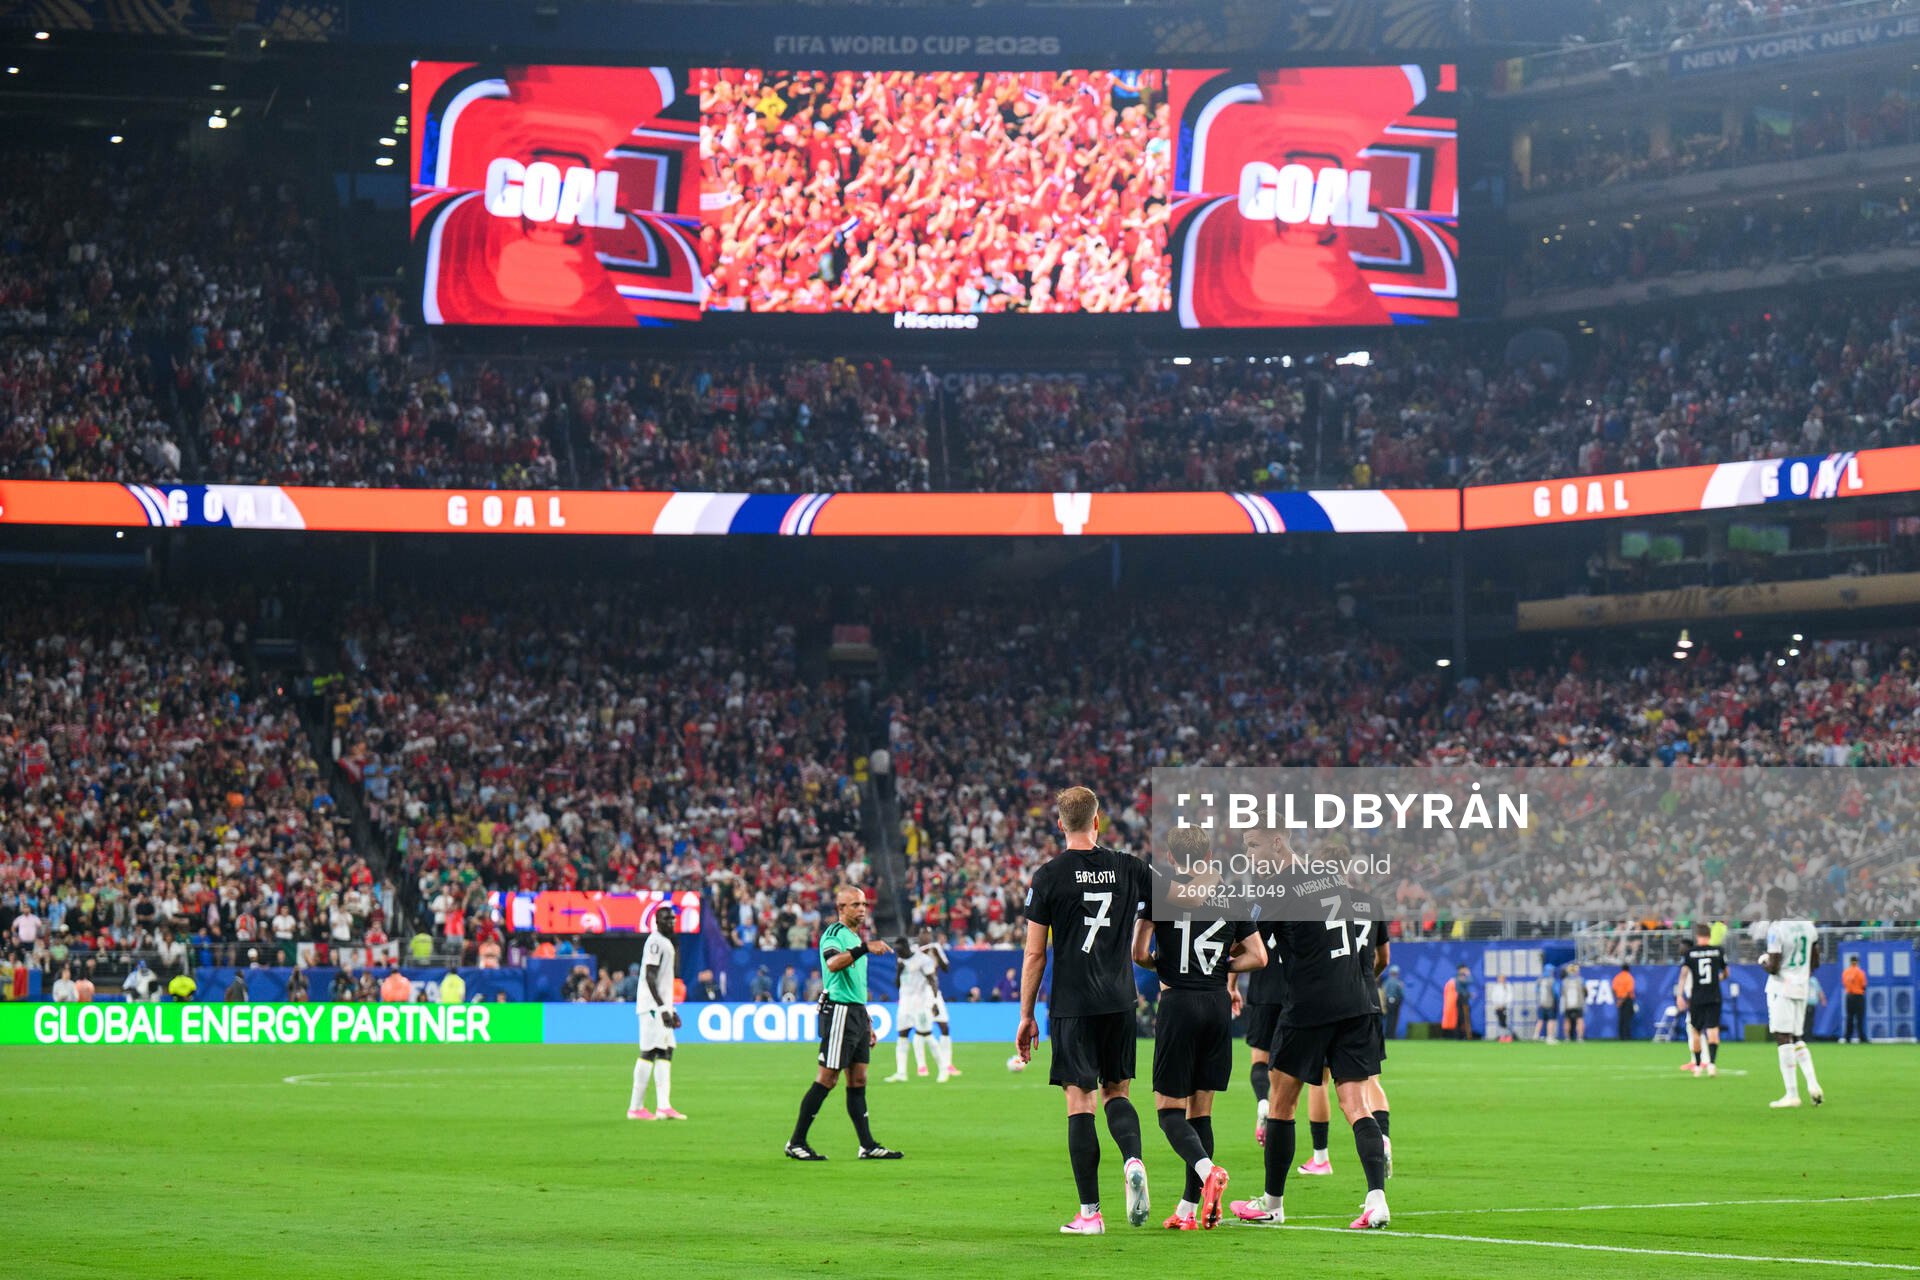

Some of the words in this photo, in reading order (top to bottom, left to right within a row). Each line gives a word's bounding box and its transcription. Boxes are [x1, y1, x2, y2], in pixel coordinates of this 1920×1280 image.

[774, 36, 824, 54] FIFA
[830, 36, 918, 54] WORLD
[922, 36, 970, 54] CUP
[975, 36, 1060, 55] 2026
[1682, 48, 1738, 70] NEW
[1746, 36, 1814, 59] YORK
[1821, 25, 1881, 47] NEW
[484, 157, 626, 229] GOAL
[1238, 161, 1379, 228] GOAL
[894, 311, 979, 329] Hisense
[1761, 457, 1864, 499] GOAL
[167, 489, 287, 523] GOAL
[447, 495, 566, 527] GOAL
[1534, 479, 1629, 518] GOAL
[1081, 891, 1113, 954] 7
[1352, 919, 1371, 952] 7
[1174, 911, 1227, 975] 16
[1698, 958, 1712, 985] 5
[1585, 979, 1615, 1005] FA
[34, 1005, 174, 1043] GLOBAL
[181, 1005, 325, 1043] ENERGY
[331, 1005, 491, 1043] PARTNER
[698, 1003, 892, 1041] aramo
